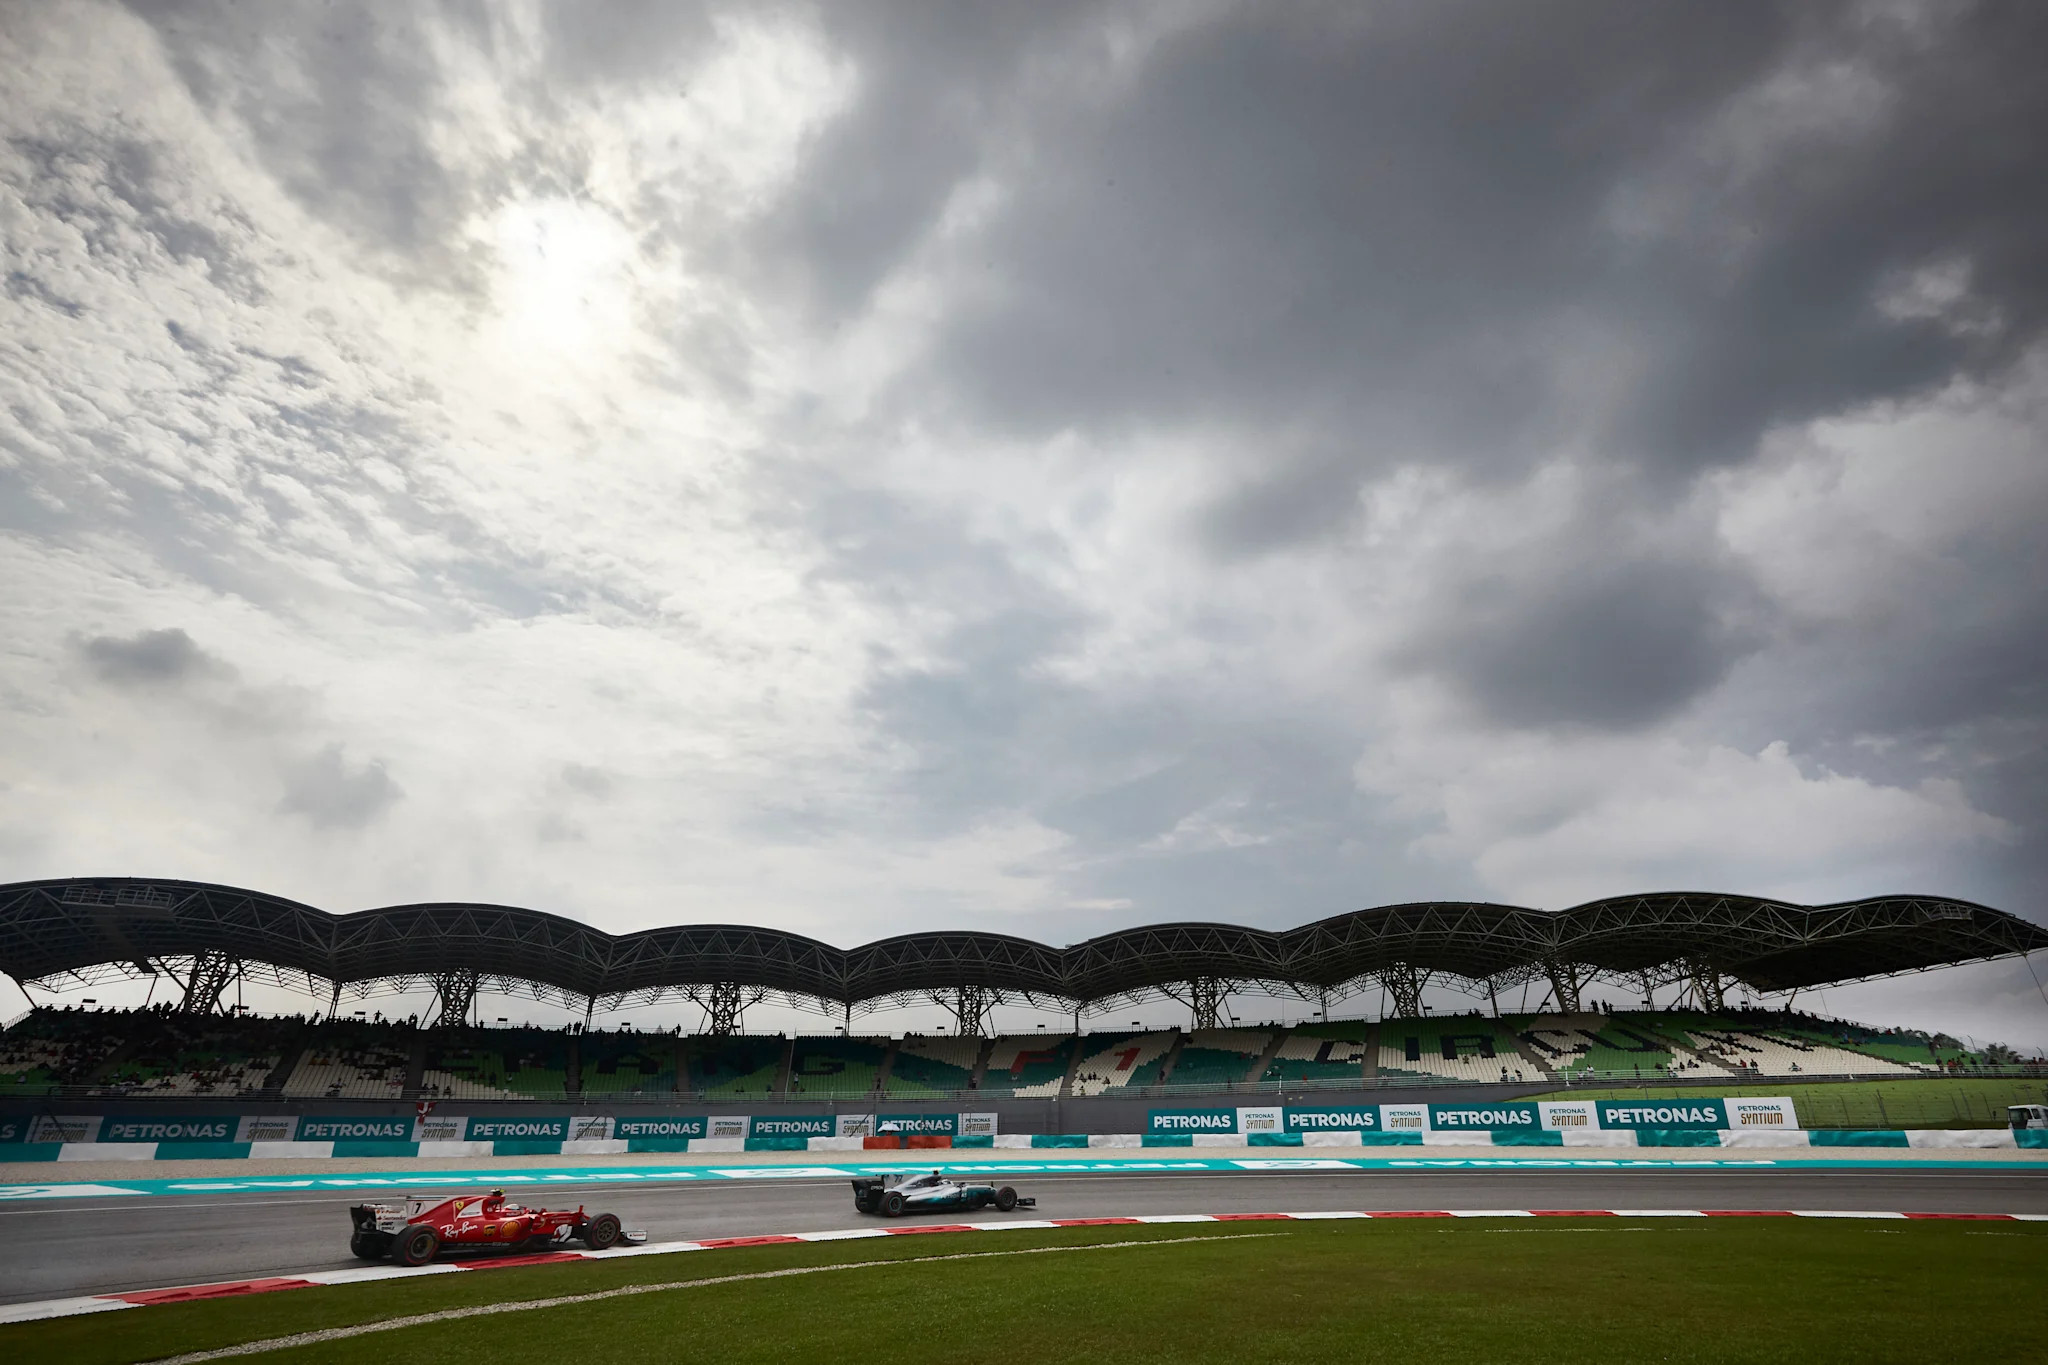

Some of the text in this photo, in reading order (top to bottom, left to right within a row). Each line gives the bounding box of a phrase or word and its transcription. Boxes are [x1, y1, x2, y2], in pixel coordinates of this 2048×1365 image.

[1153, 1115, 1231, 1129] PETRONAS
[1289, 1112, 1374, 1127] PETRONAS
[1436, 1110, 1533, 1125] PETRONAS
[1552, 1115, 1587, 1126] SYNTIUM
[1606, 1107, 1718, 1124] PETRONAS
[1741, 1113, 1783, 1124] SYNTIUM
[620, 1122, 701, 1135] PETRONAS
[755, 1121, 830, 1134] PETRONAS
[1245, 1119, 1275, 1130] SYNTIUM
[1390, 1117, 1422, 1128] SYNTIUM
[108, 1123, 228, 1139] PETRONAS
[303, 1123, 405, 1137] PETRONAS
[421, 1128, 456, 1139] SYNTIUM
[472, 1123, 561, 1136] PETRONAS
[714, 1126, 742, 1136] SYNTIUM
[414, 1202, 422, 1214] 7
[440, 1221, 478, 1238] Ray-Ban
